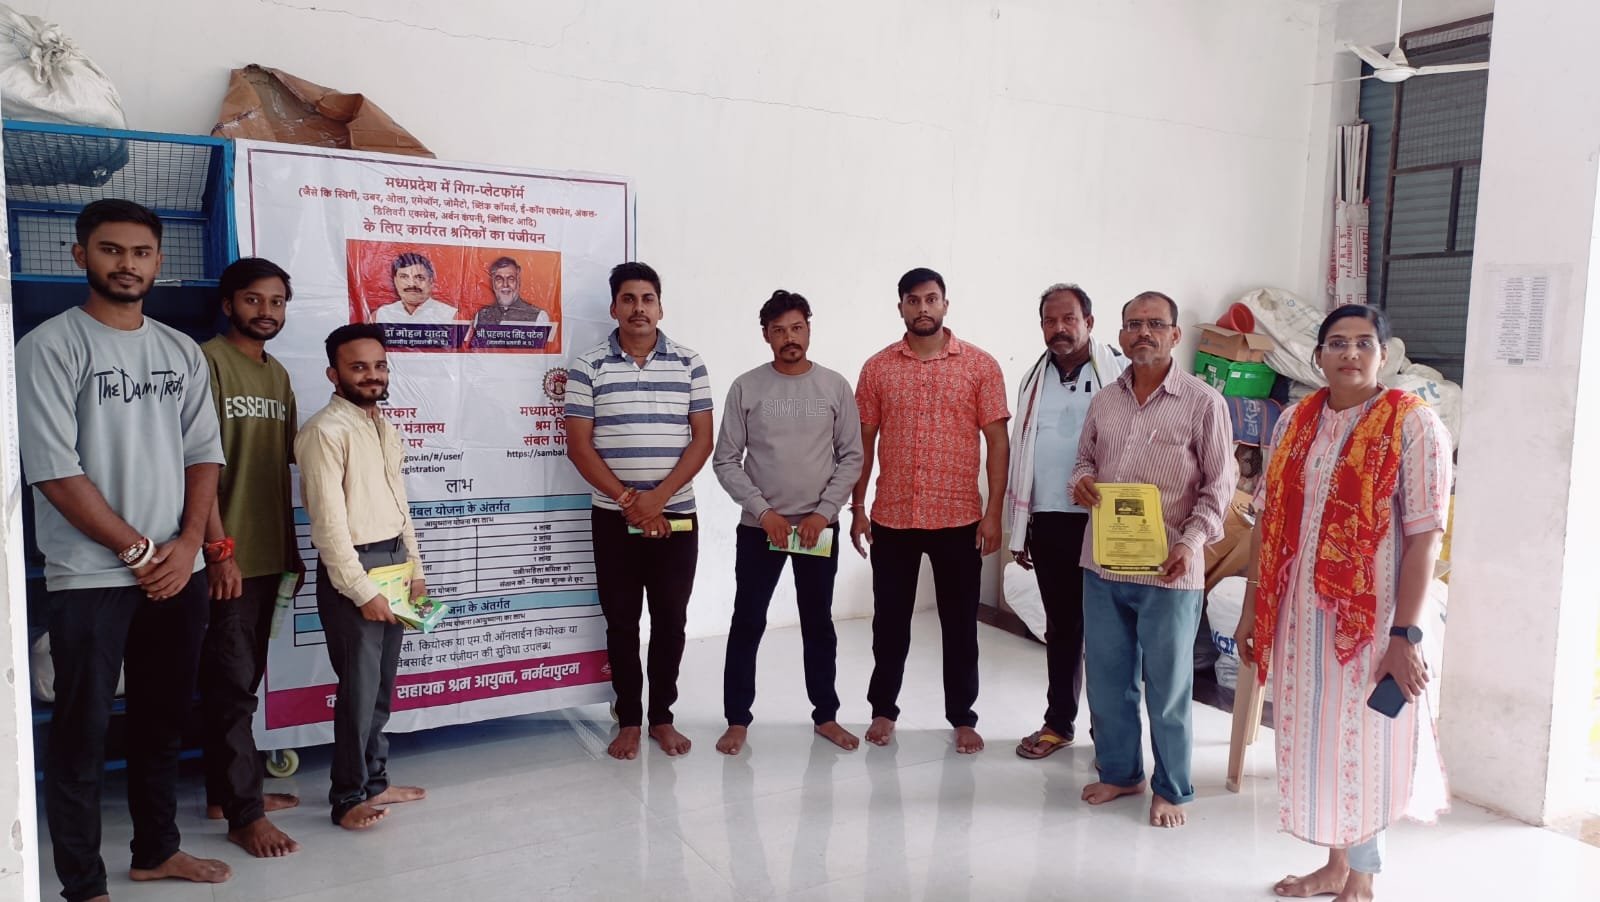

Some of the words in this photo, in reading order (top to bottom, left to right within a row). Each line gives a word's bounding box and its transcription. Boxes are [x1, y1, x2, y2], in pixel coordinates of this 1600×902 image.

[385, 176, 436, 192] मध्यप्रदेश
[441, 178, 450, 193] में
[453, 180, 525, 199] गिग-प्लेटफॉर्म
[298, 185, 318, 198] (जैसे
[320, 187, 332, 198] कि
[334, 188, 360, 201] स्विगी,
[362, 192, 383, 203] उबर,
[386, 193, 408, 205] ओला,
[444, 197, 469, 209] जोमैटो,
[494, 201, 518, 213] कॉमर्स,
[520, 205, 544, 215] ई-कॉम
[374, 206, 406, 216] डिलिवरी
[442, 212, 460, 221] अर्बन
[462, 213, 485, 224] कंपनी,
[517, 217, 537, 228] आदि)
[363, 218, 376, 232] के
[380, 219, 403, 236] लिए
[406, 222, 447, 237] कार्यरत
[450, 224, 486, 240] श्रमिकों
[490, 230, 504, 241] का
[508, 230, 546, 244] पंजीयन
[396, 328, 422, 338] मोहन
[424, 330, 449, 338] यादव
[476, 328, 485, 338] श्री
[512, 329, 526, 339] सिंह
[526, 331, 544, 339] पटेल
[94, 370, 120, 405] The
[763, 398, 828, 417] SIMPLE
[404, 421, 445, 434] मंत्रालय
[535, 420, 552, 430] श्रम
[408, 438, 424, 449] पर
[524, 434, 550, 446] संबल
[404, 452, 464, 464] gov.in/#/user/
[507, 449, 568, 460] https://sambal.
[445, 478, 474, 494] लाभ
[434, 503, 465, 516] योजना
[467, 502, 476, 513] के
[480, 501, 512, 513] अंतर्गत
[448, 604, 466, 615] जना
[468, 601, 477, 613] के
[480, 599, 512, 611] अंतर्गत
[418, 638, 454, 652] कियोस्क
[456, 638, 465, 647] या
[534, 625, 566, 637] कियोस्क
[568, 625, 578, 634] या
[436, 654, 447, 664] पर
[450, 650, 480, 664] पंजीयन
[482, 646, 494, 658] की
[496, 645, 521, 659] सुविधा
[523, 642, 552, 653] उपलब्ध
[396, 680, 446, 699] सहायक
[448, 676, 472, 692] श्रम
[474, 671, 518, 691] आयुक्त,
[521, 662, 581, 682] नर्मदापुरम
